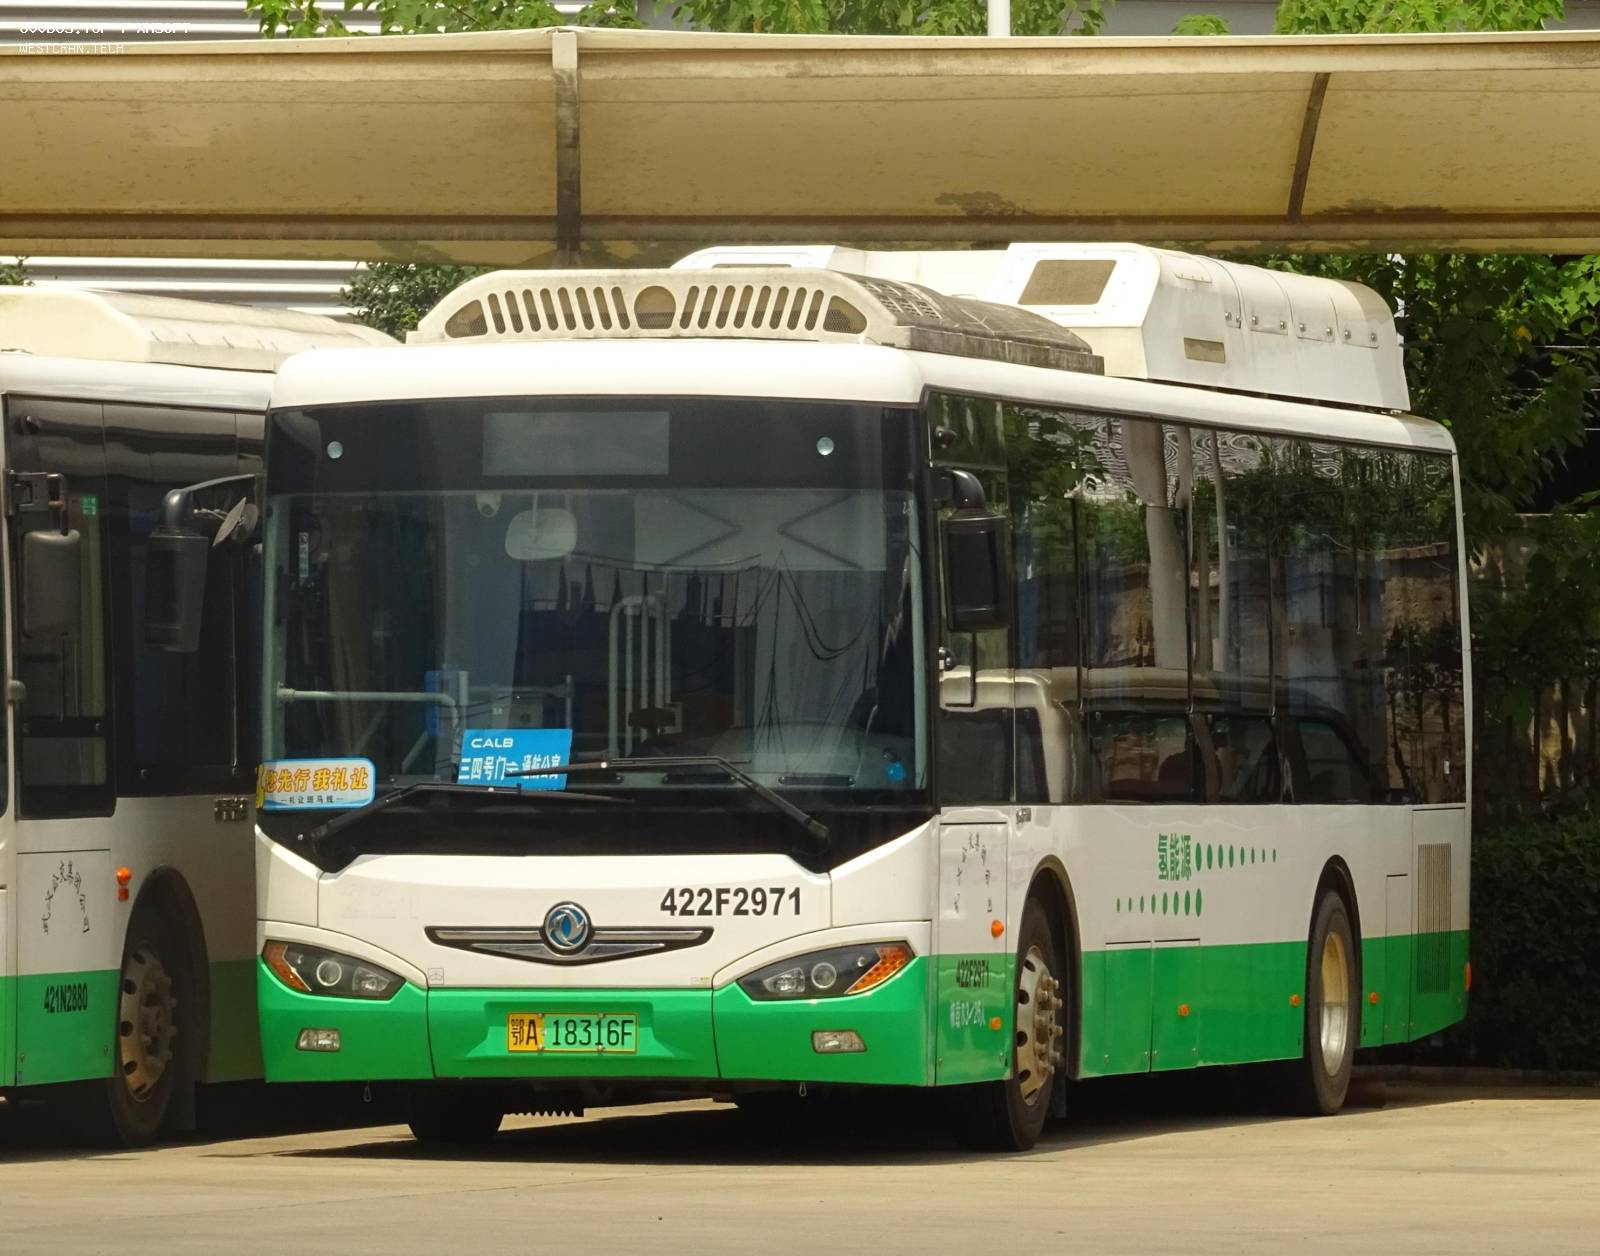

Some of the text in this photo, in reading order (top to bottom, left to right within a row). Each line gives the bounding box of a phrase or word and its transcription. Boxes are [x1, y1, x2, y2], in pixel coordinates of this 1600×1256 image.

[471, 738, 514, 748] CALB
[459, 755, 507, 780] 三四号门
[660, 887, 801, 916] 422F2971
[44, 983, 88, 1013] 421N2880
[511, 1018, 634, 1046] 鄂A 18316F
